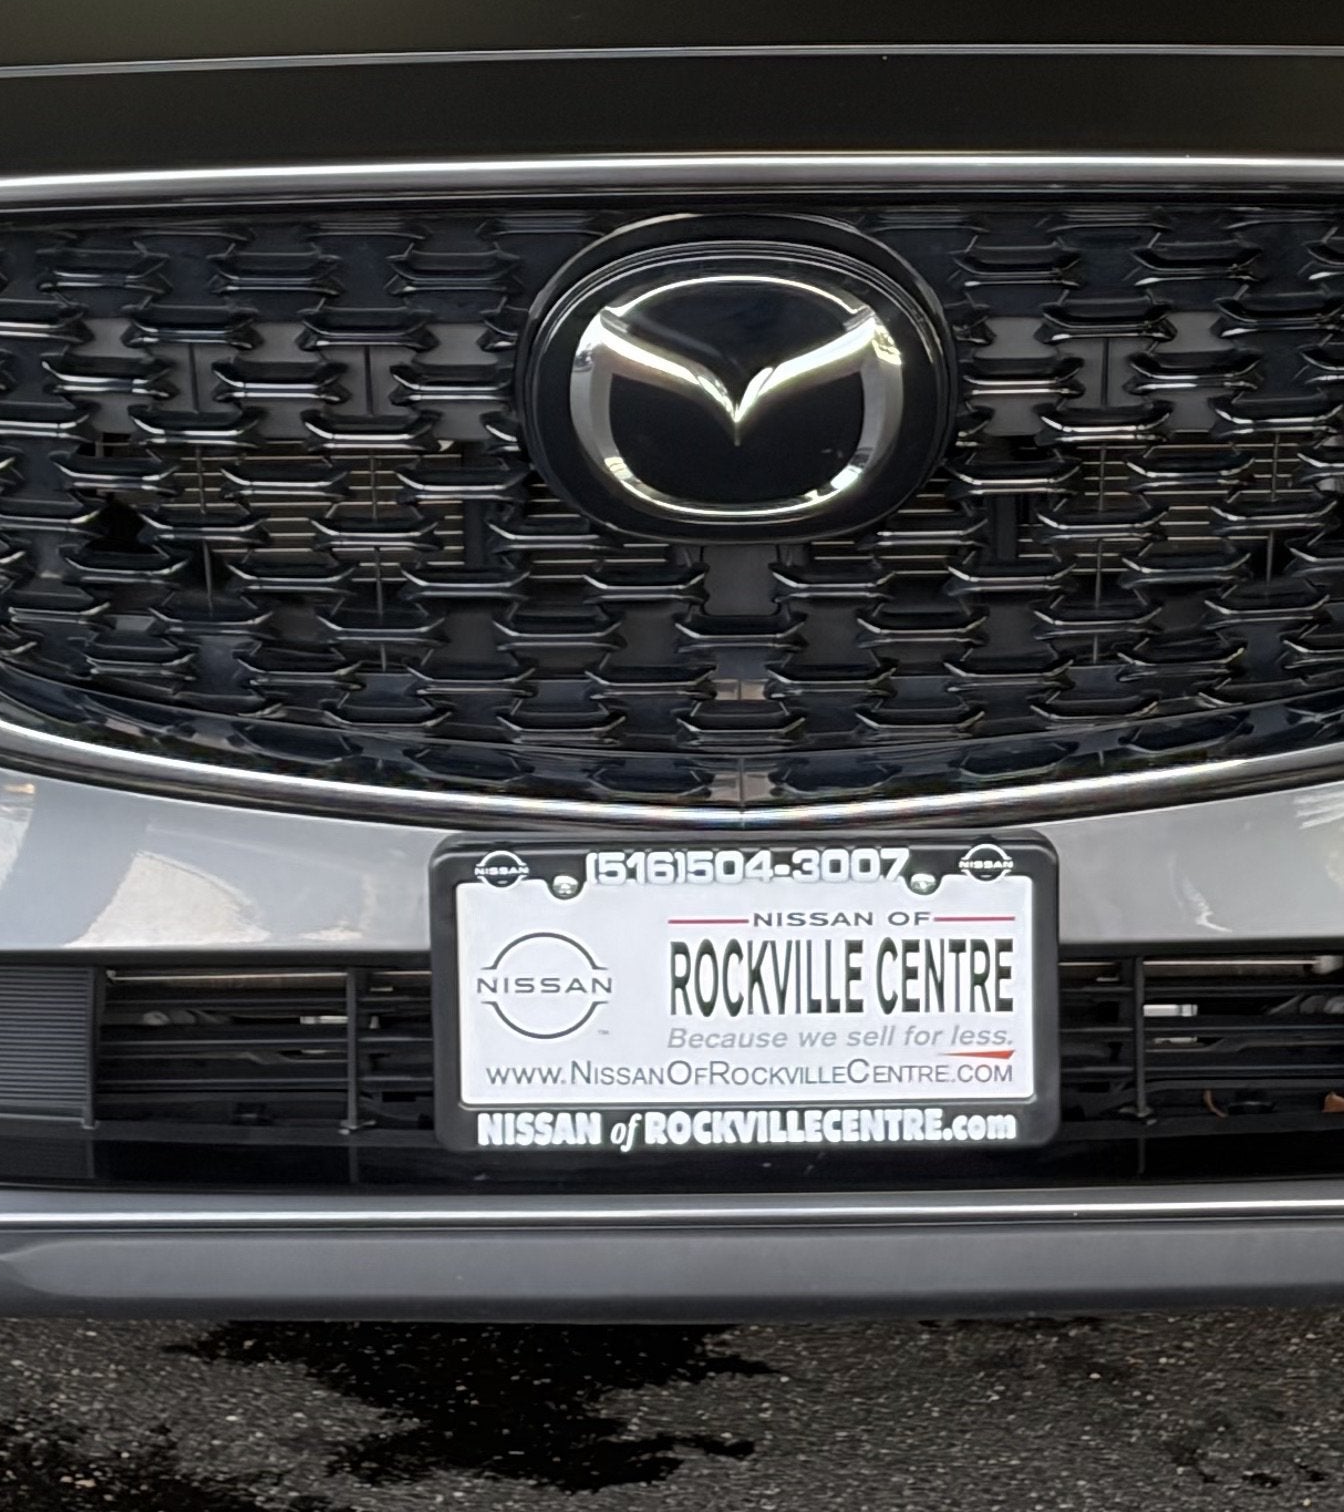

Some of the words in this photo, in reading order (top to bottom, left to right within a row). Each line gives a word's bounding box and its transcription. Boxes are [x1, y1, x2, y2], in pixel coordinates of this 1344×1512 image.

[474, 866, 530, 876] NISSAN
[586, 847, 910, 885] (516)504-3007
[959, 860, 1014, 870] NISSAN
[753, 912, 873, 927] NISSAN
[887, 911, 932, 926] OF
[476, 977, 613, 995] NISSAN
[670, 938, 864, 1017] ROCKVILLE
[876, 937, 1014, 1015] CENTRE
[667, 1028, 788, 1049] Because
[800, 1031, 836, 1047] we
[846, 1025, 896, 1047] sell
[904, 1025, 944, 1046] for
[950, 1024, 1014, 1046] less.
[477, 1112, 602, 1146] NISSAN
[610, 1113, 643, 1153] of
[644, 1108, 1017, 1145] ROCKVILLECENTRE.com
